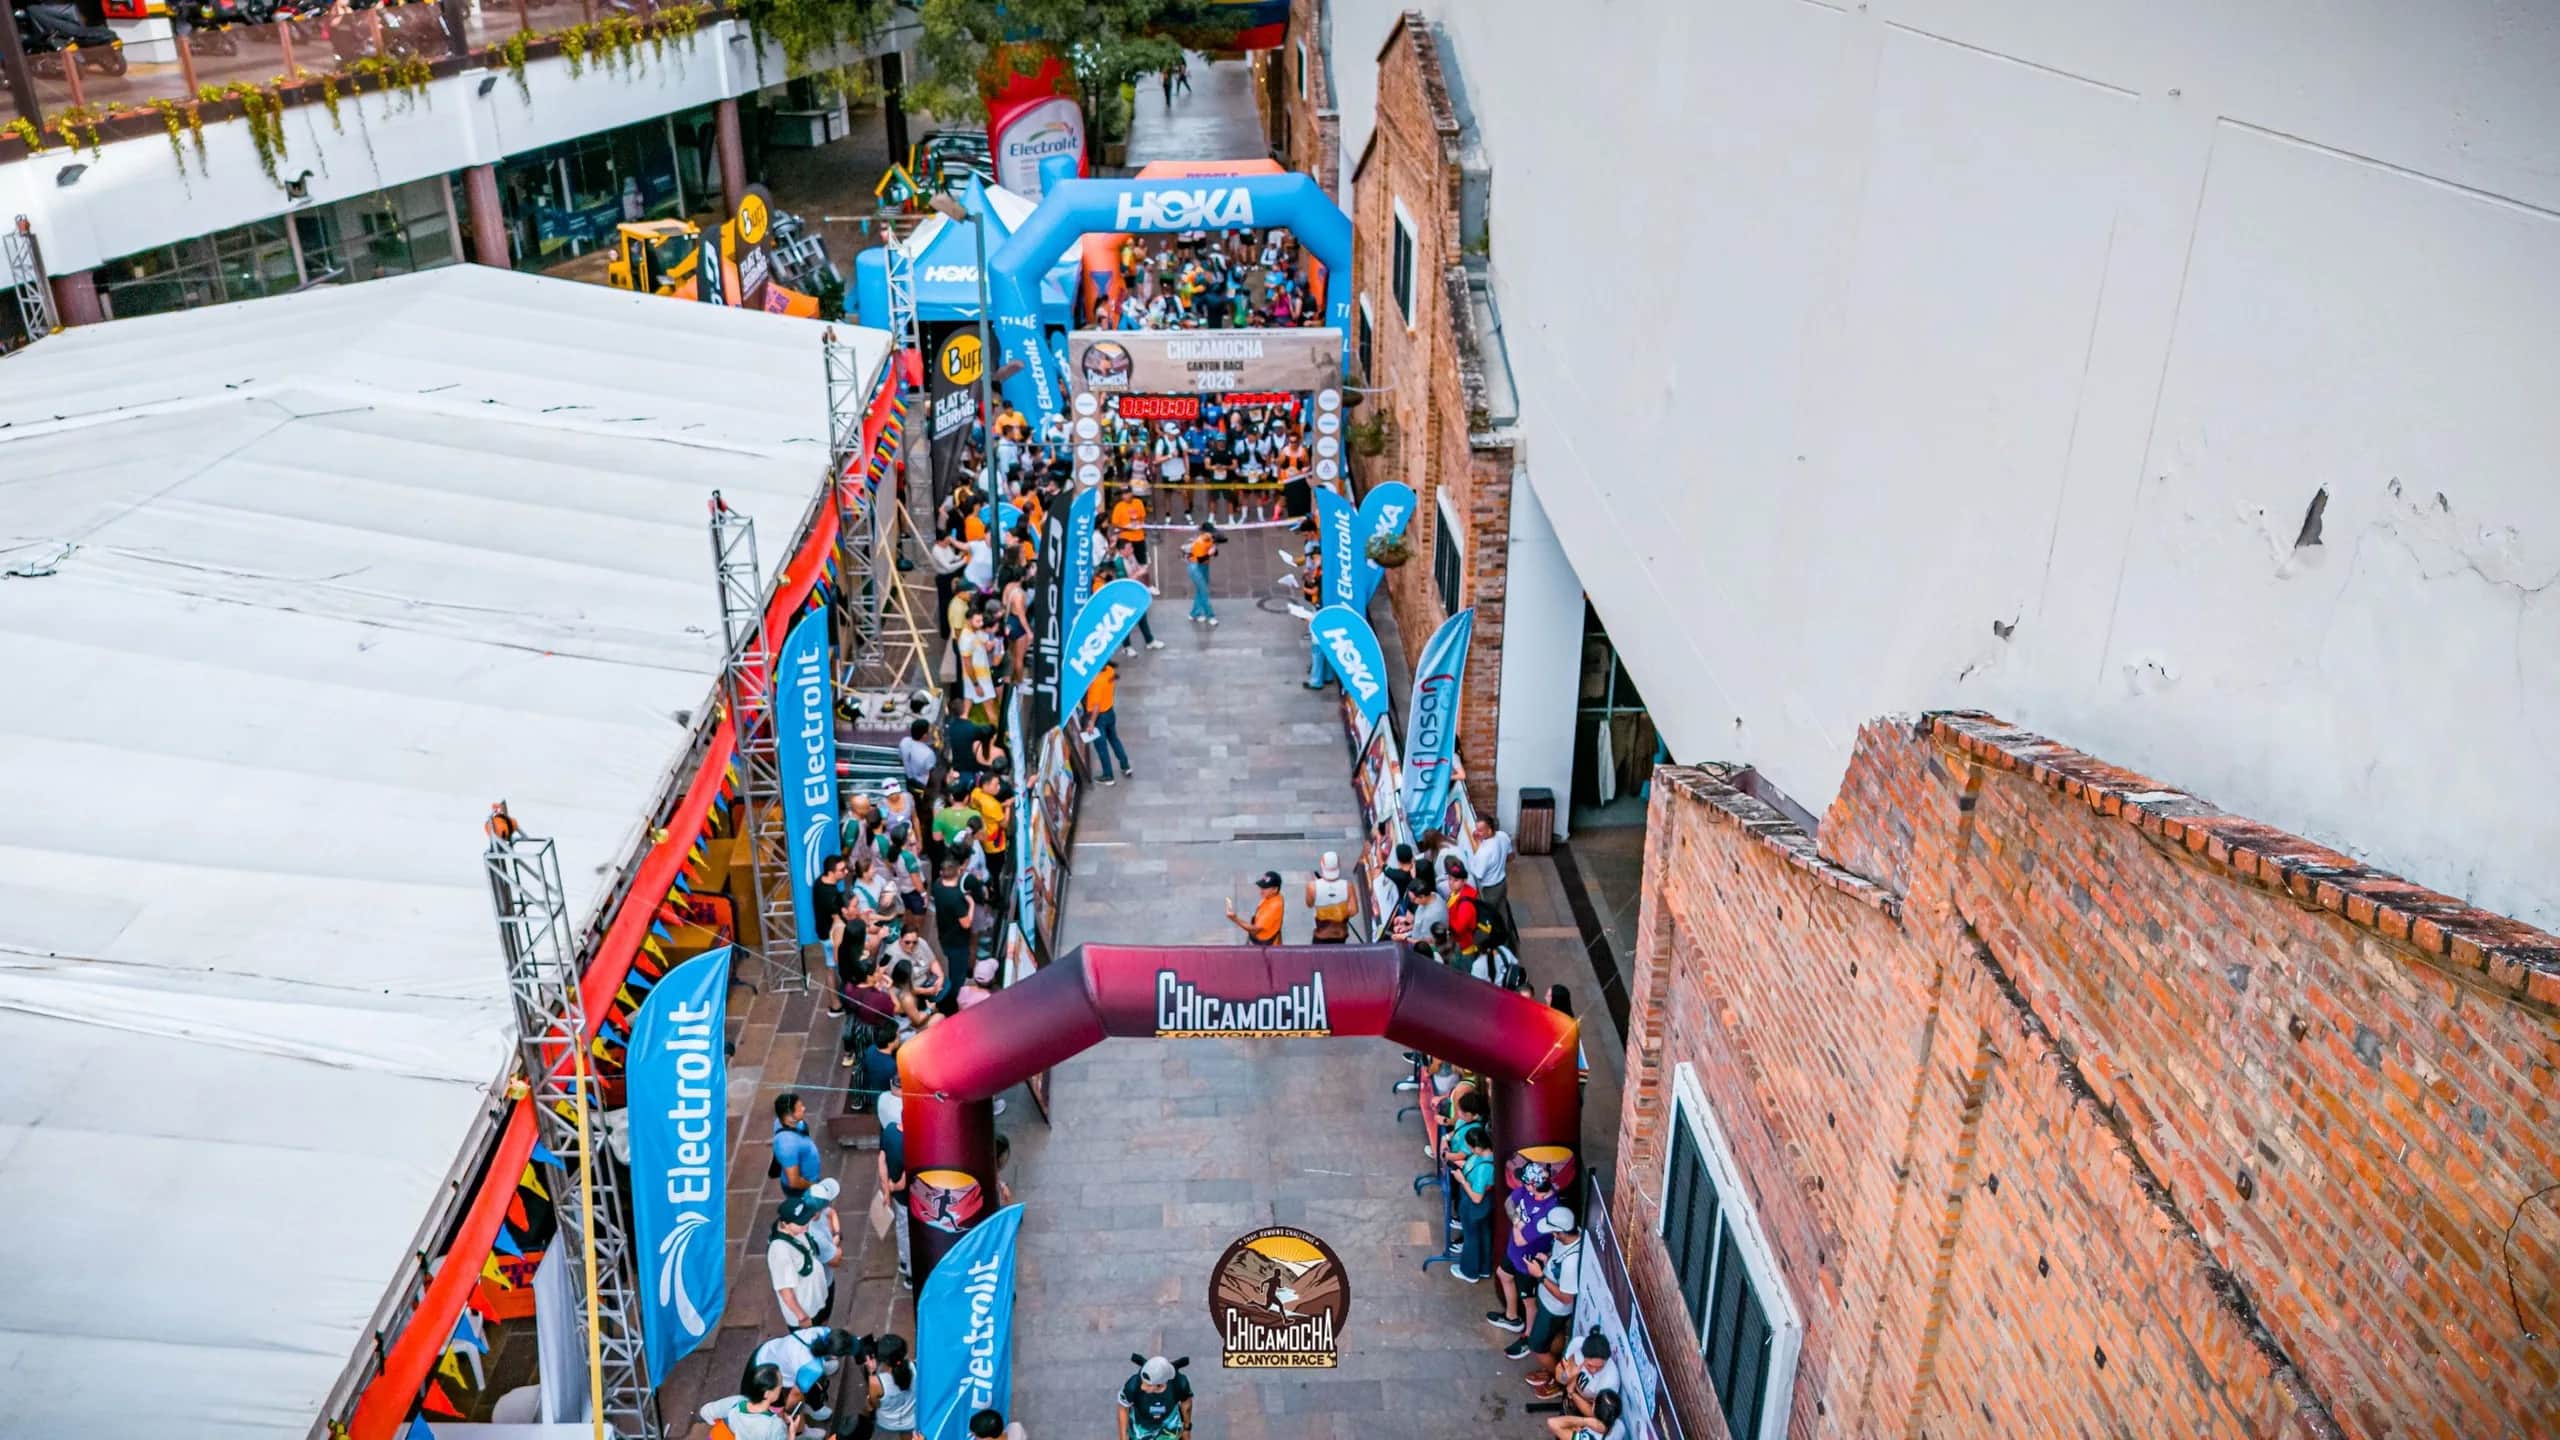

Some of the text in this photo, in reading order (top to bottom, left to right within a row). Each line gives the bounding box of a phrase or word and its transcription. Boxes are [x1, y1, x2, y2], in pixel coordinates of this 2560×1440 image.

[1009, 135, 1079, 156] Electrolit
[1115, 187, 1254, 230] HOKA
[925, 265, 979, 282] HOK
[1023, 337, 1053, 409] Electrolit
[1167, 340, 1264, 359] CHICAMOCHA
[1186, 361, 1243, 371] CANYON RACE
[1197, 372, 1235, 391] 2026
[935, 391, 960, 416] FLAT
[935, 399, 975, 432] BORING
[1073, 514, 1091, 603] Electrolit
[1336, 508, 1352, 599] Electrolit
[1037, 582, 1060, 712] Julbo
[1069, 602, 1137, 676] HOKA
[1322, 627, 1380, 702] HOKA
[796, 640, 828, 807] Electrolit
[1158, 971, 1328, 1030] CHICAMOCHA
[666, 1000, 711, 1205] Electrolit
[963, 1252, 999, 1409] Electrolit
